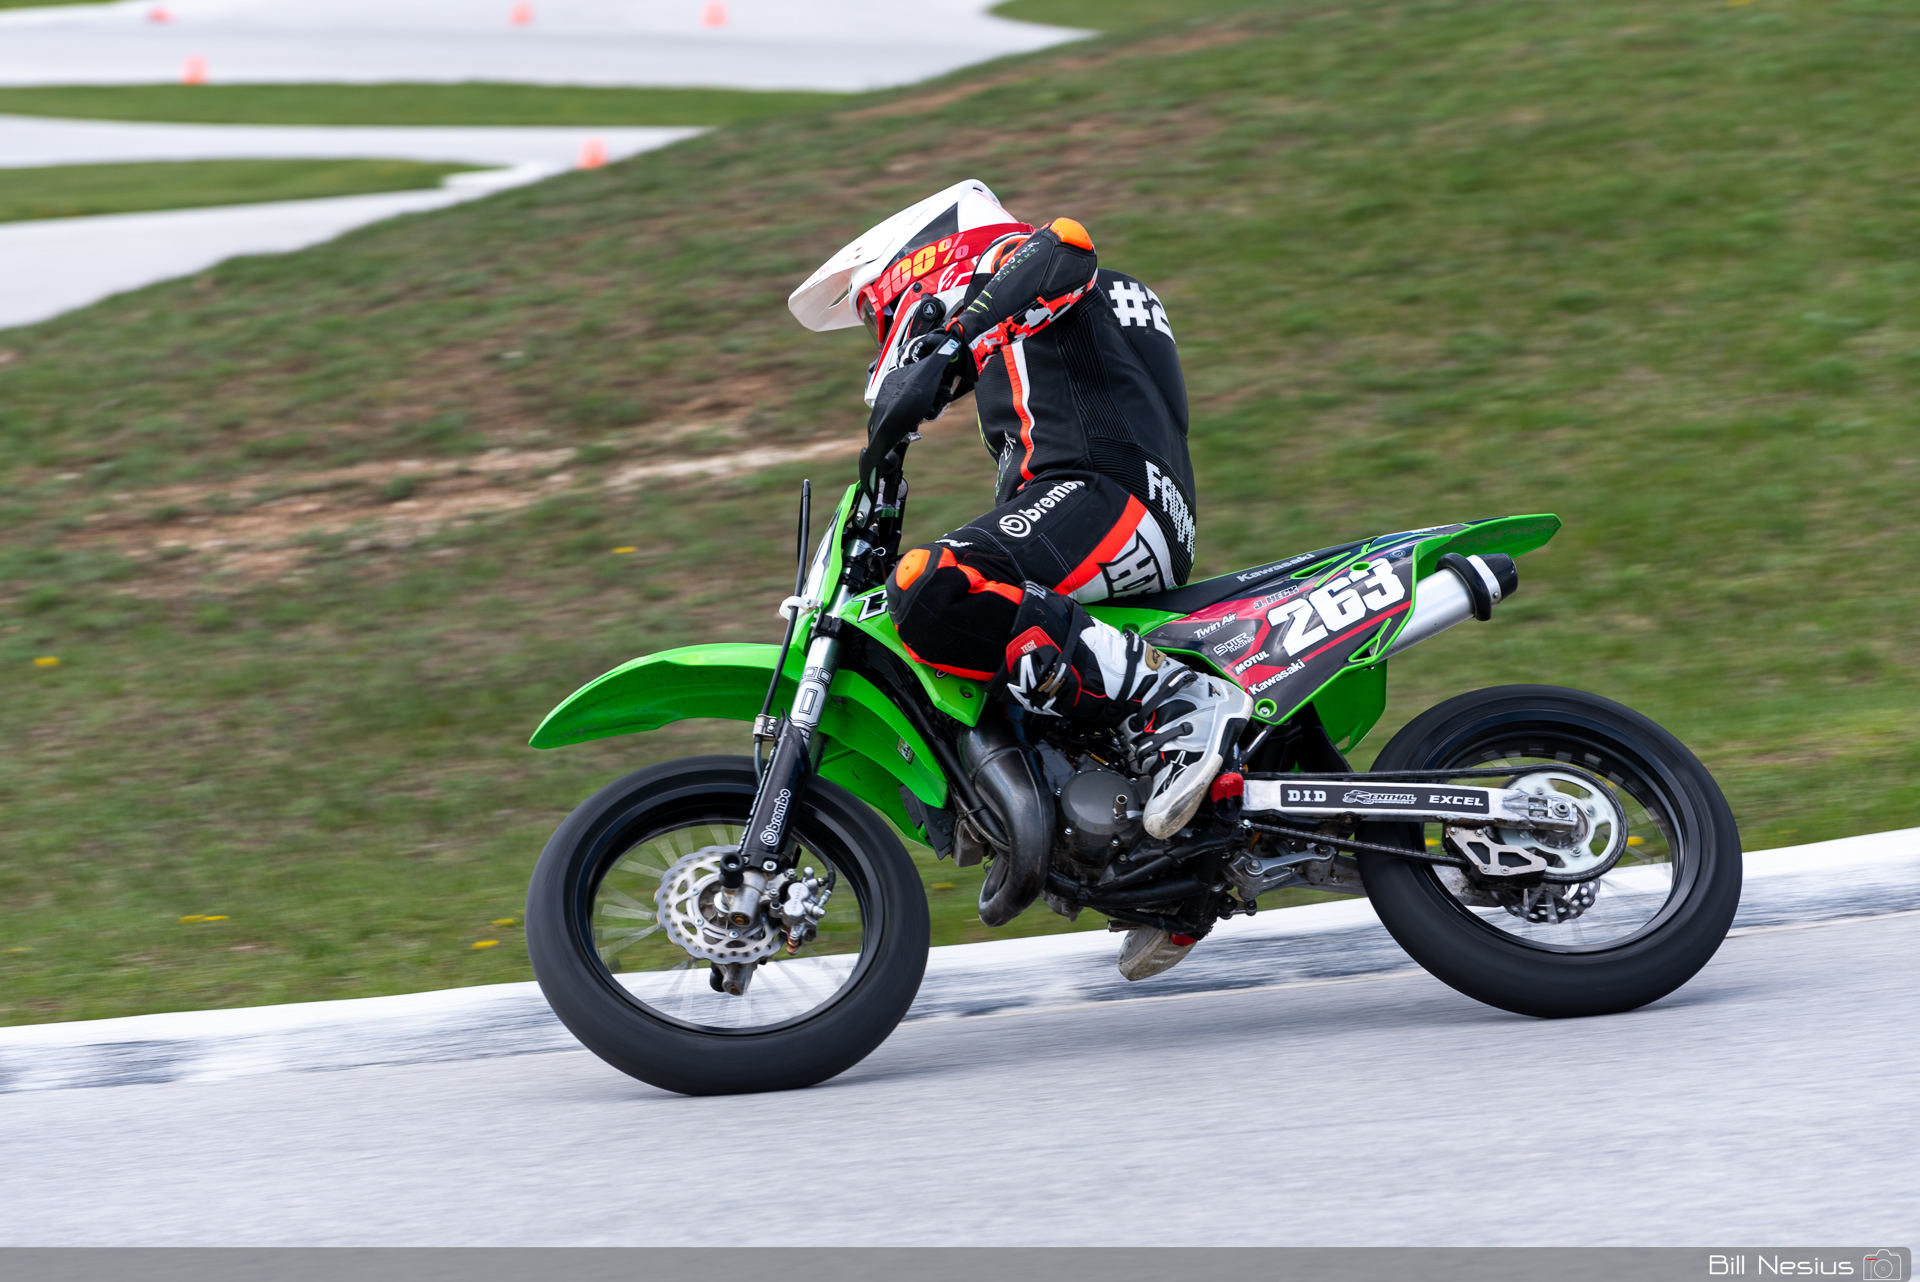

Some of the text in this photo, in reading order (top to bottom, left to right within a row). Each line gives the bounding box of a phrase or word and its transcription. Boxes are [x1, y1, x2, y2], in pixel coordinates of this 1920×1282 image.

[878, 233, 969, 304] 100%
[1236, 553, 1316, 582] Kawasaki
[1265, 585, 1300, 606] HECK
[1267, 558, 1406, 657] 263
[1193, 621, 1222, 639] Twin
[1221, 613, 1237, 627] Air
[1229, 636, 1256, 654] RACING
[1234, 650, 1270, 675] MOTUL
[1247, 658, 1306, 696] Kawasaki
[1429, 794, 1484, 807] EXCEL
